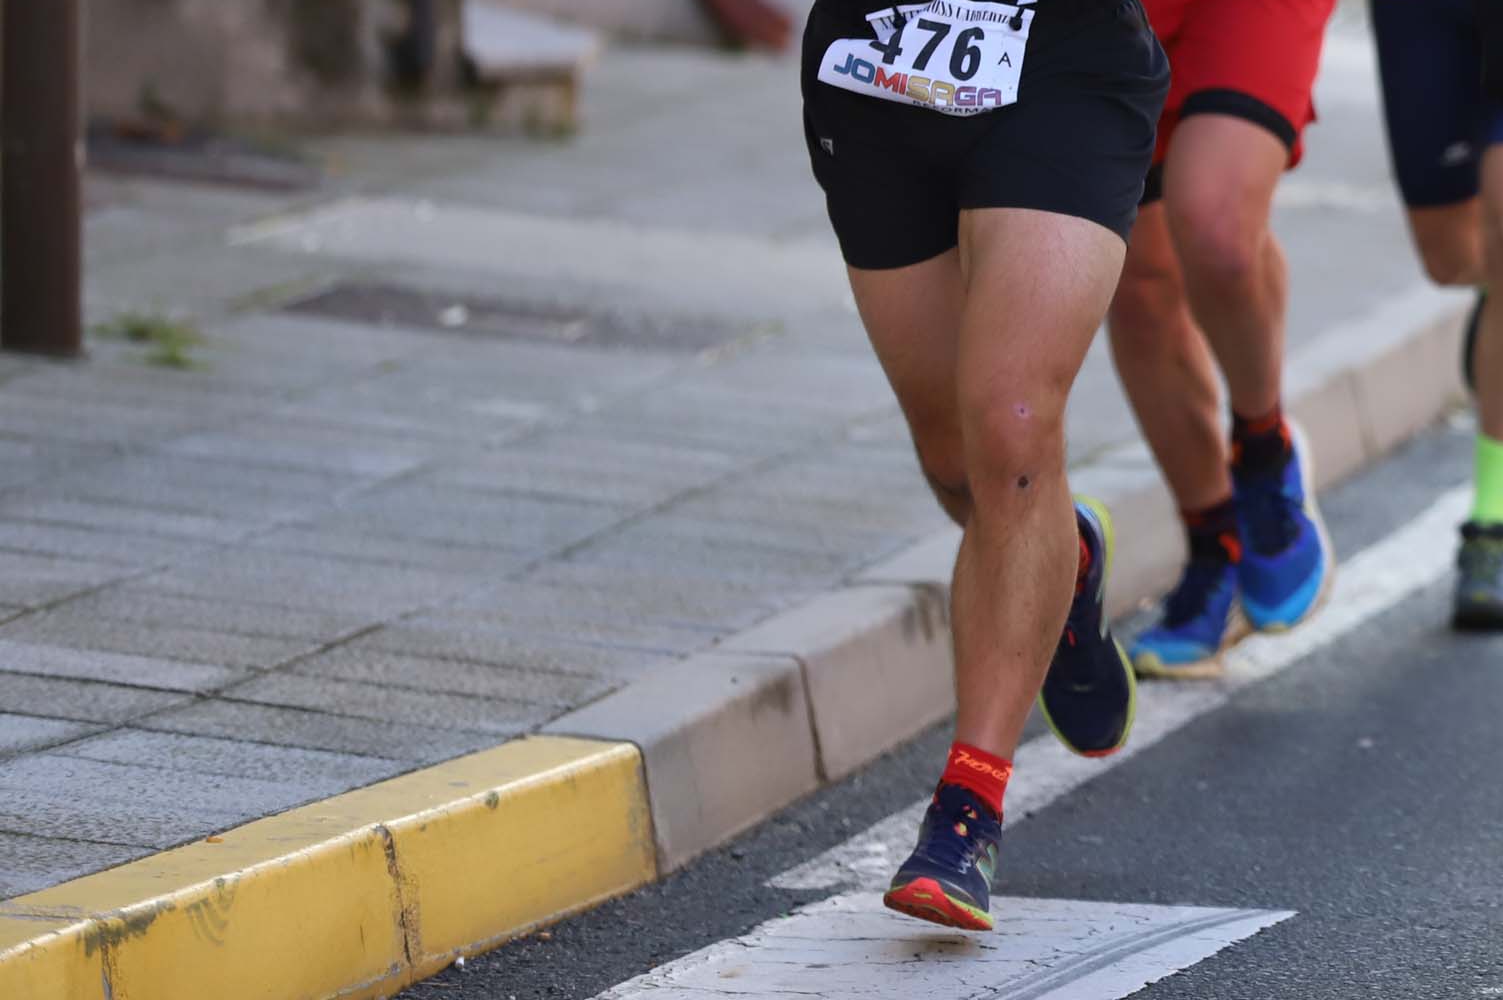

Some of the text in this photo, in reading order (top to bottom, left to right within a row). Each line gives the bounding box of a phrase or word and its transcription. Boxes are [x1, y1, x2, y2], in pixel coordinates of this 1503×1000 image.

[868, 17, 986, 82] 476
[998, 51, 1012, 69] A
[832, 53, 1003, 107] JOMISAGA
